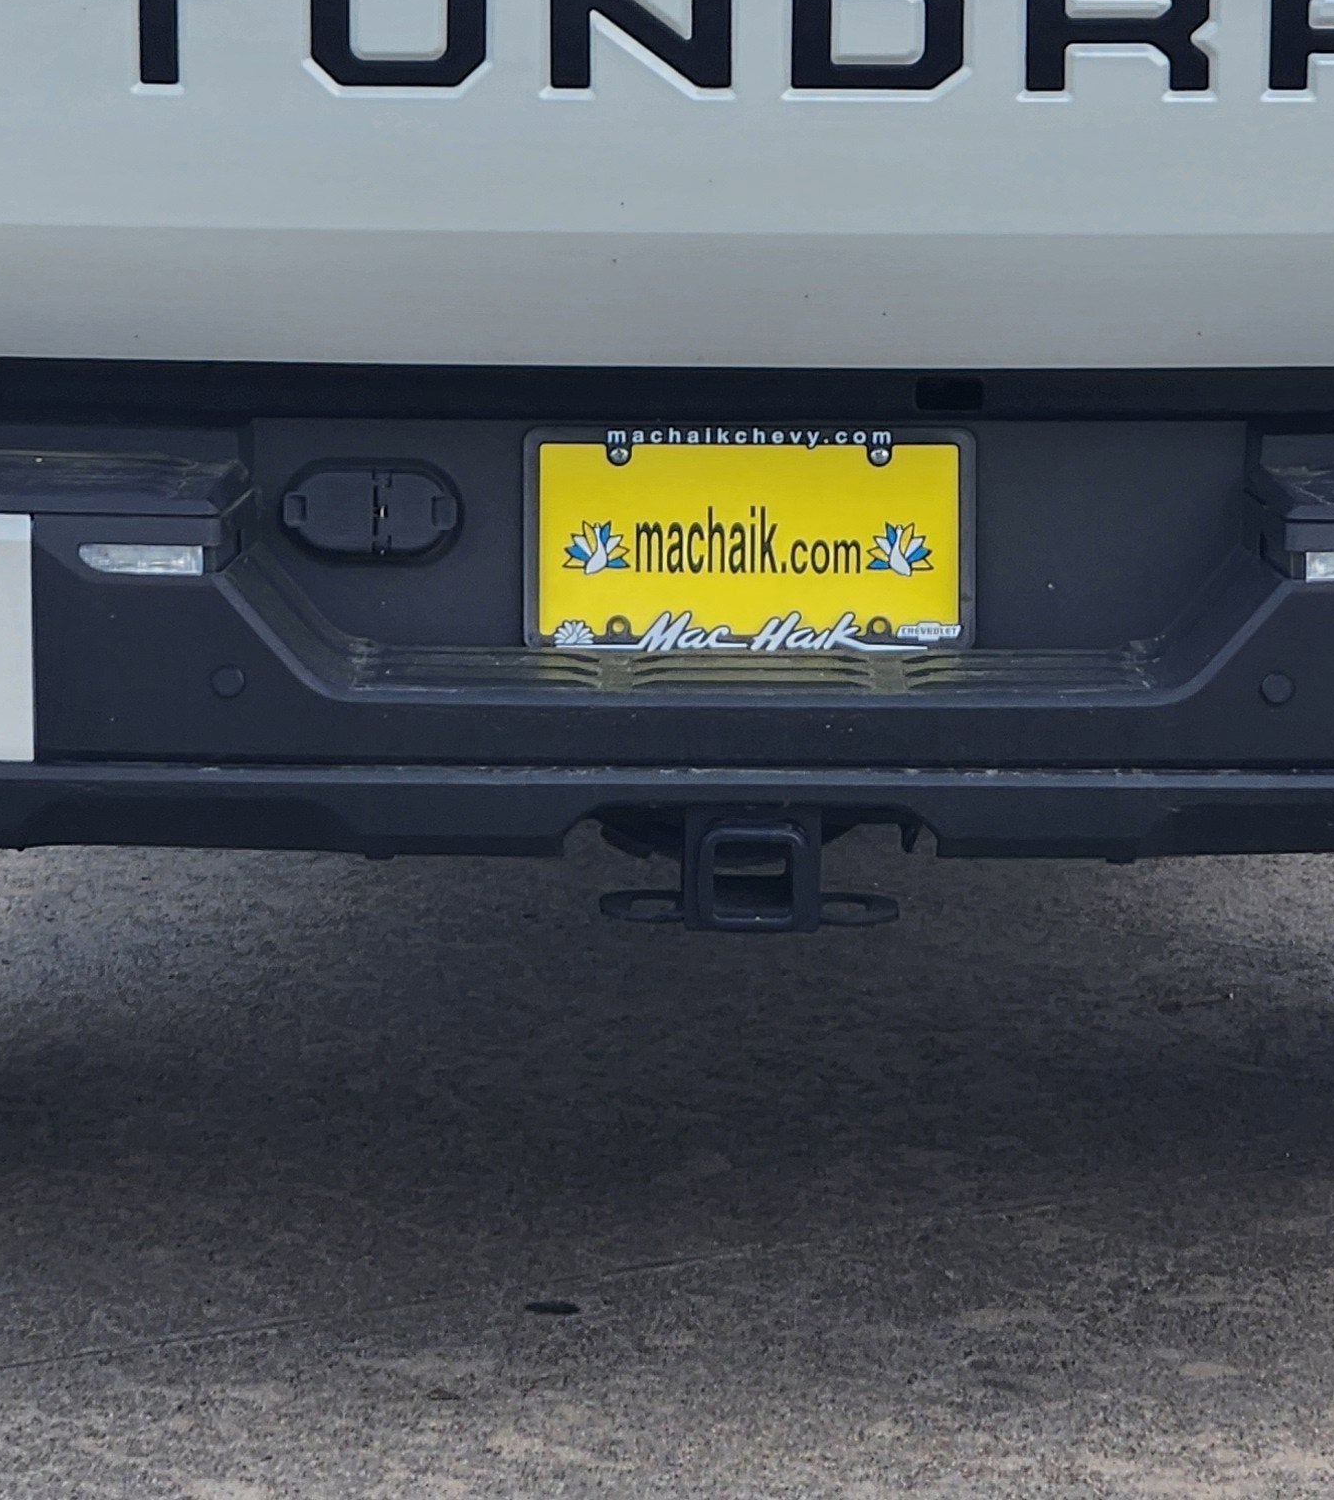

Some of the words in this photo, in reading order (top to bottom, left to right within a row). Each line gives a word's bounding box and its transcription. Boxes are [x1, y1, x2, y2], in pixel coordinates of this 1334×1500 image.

[607, 427, 893, 450] machaikchevy.com
[634, 506, 862, 575] machaik.com
[637, 610, 748, 652] Mac
[750, 610, 867, 652] Haik
